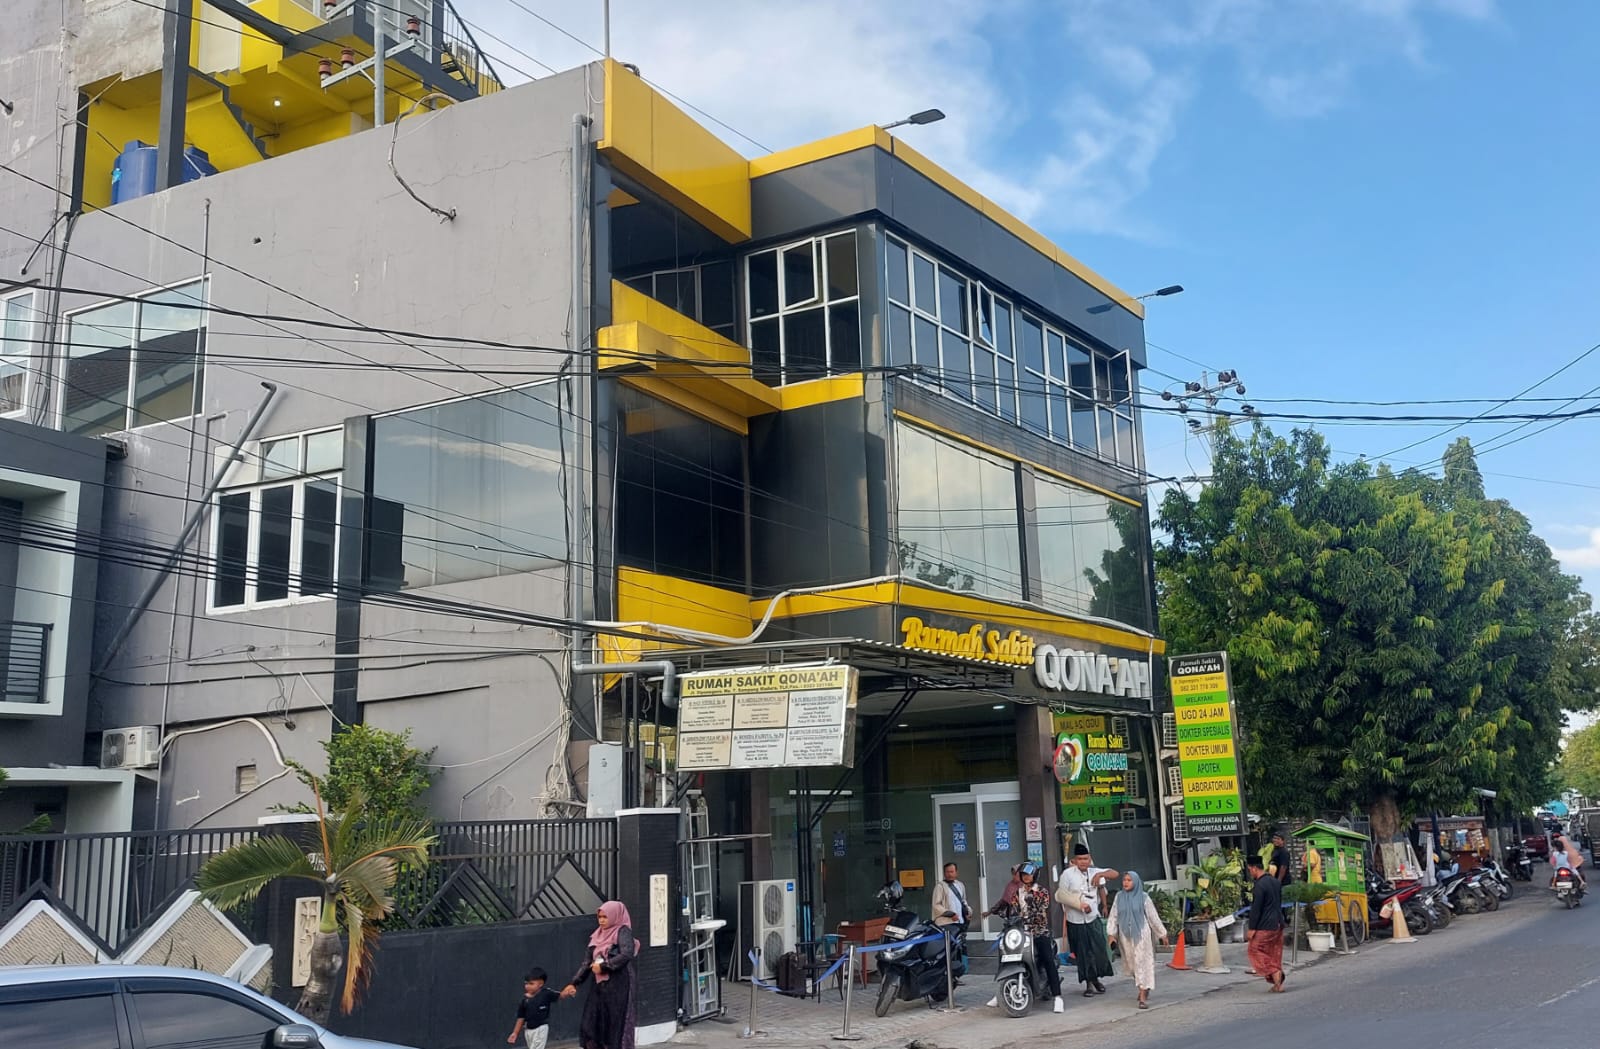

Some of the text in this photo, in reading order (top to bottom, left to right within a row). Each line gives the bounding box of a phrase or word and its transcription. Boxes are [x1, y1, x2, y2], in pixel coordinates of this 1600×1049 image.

[901, 616, 1036, 665] Rumah Sakit
[1035, 644, 1150, 698] QONA'AH
[1177, 664, 1220, 674] QONA'AH
[687, 678, 732, 690] RUMAH
[736, 675, 775, 687] SAKIT
[779, 671, 838, 684] QONA'AH
[1181, 707, 1224, 720] UGD 24 JAM
[1179, 724, 1230, 739] DOKTER SPESIALIS
[1185, 743, 1228, 756] DOKTER UMUM
[1198, 763, 1221, 774] APOTEK
[1188, 780, 1233, 792] LABORATORIUM
[1189, 815, 1239, 824] KESEHATAN ANDA
[953, 832, 965, 840] 24
